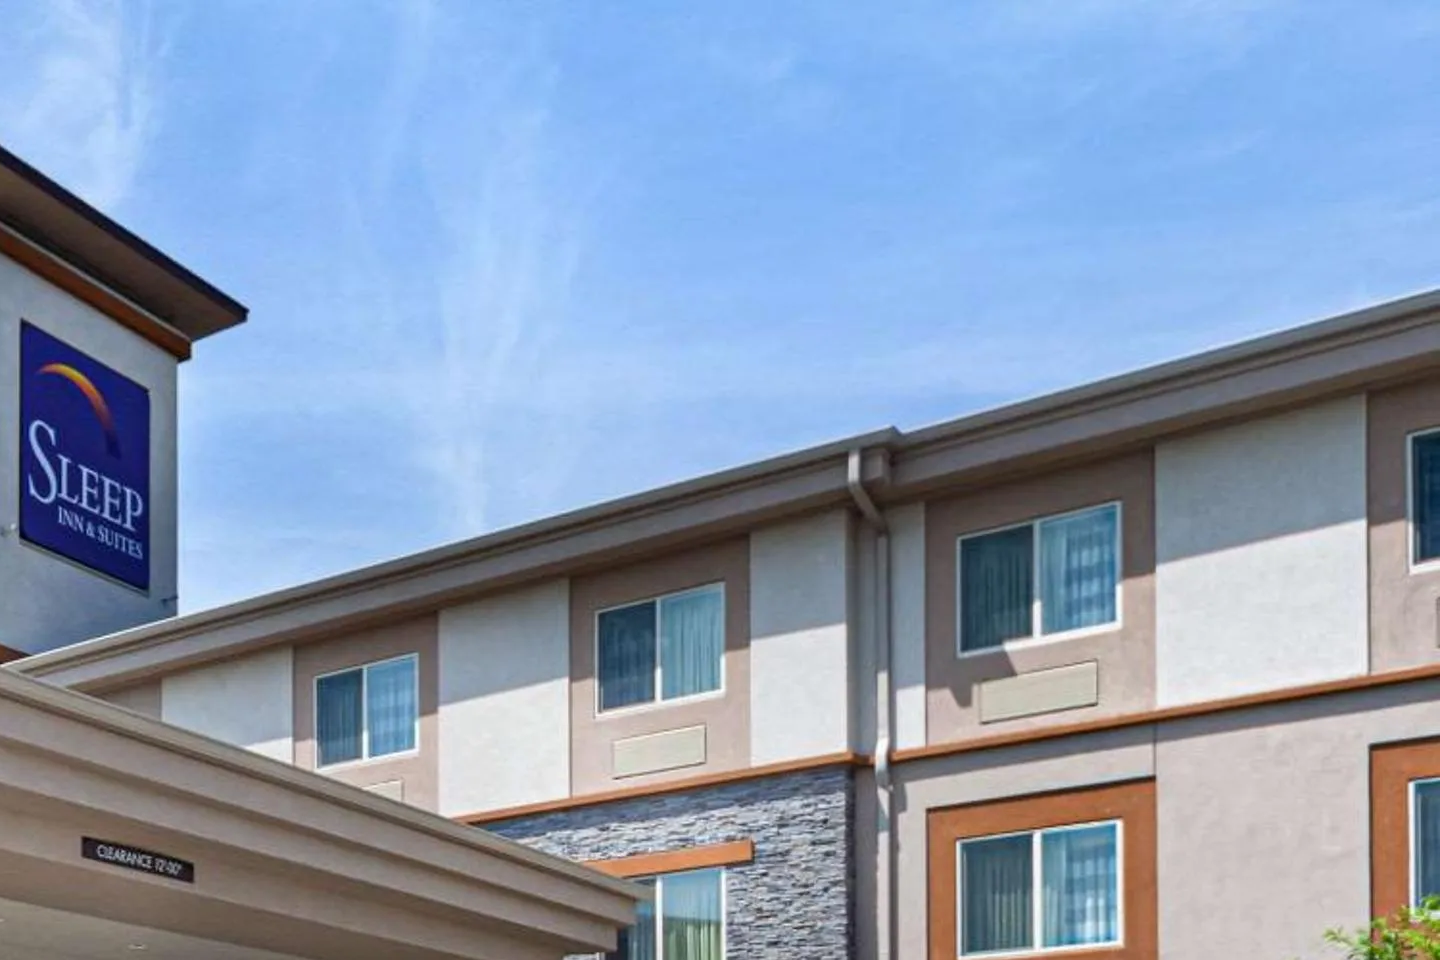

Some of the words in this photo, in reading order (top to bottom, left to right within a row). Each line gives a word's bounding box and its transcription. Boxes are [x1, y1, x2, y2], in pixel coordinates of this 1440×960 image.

[28, 419, 143, 532] SLEEP
[58, 505, 84, 533] INN
[86, 521, 96, 539] &
[97, 524, 143, 560] SUITES
[96, 844, 153, 869] CLEARANCE
